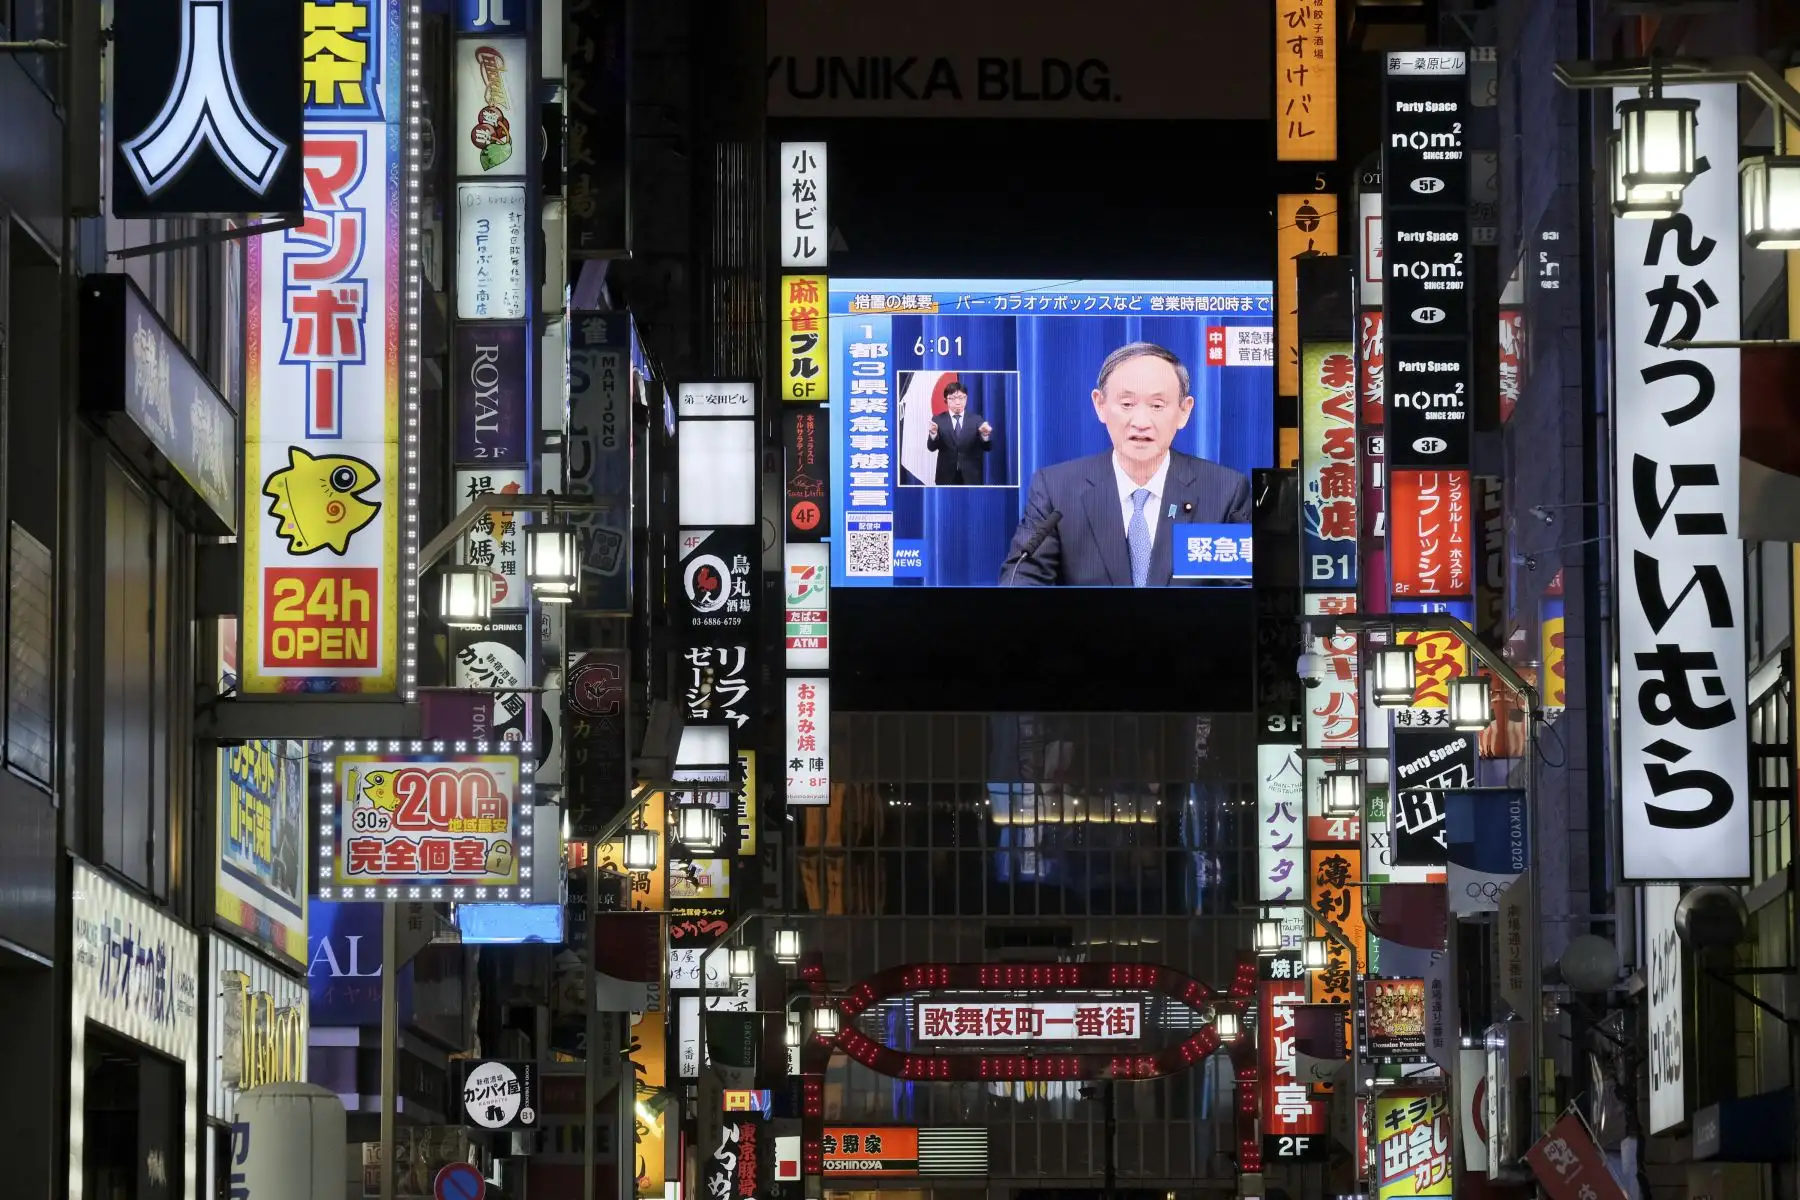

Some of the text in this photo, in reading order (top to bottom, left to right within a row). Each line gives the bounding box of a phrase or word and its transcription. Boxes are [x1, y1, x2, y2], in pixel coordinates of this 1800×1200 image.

[1389, 57, 1464, 71] 第一桑原ビル
[978, 56, 1122, 103] BLDG.
[1396, 101, 1458, 113] Party Space
[1423, 151, 1462, 160] SINCE 2007
[1418, 180, 1437, 191] 5F
[792, 150, 817, 259] 小松ビル
[1397, 231, 1459, 243] Party Space
[291, 140, 360, 431] マンボー
[1424, 281, 1464, 290] SINCE 2007
[854, 294, 932, 311] 措置の概要
[1419, 309, 1437, 321] 4F
[914, 336, 963, 358] 6:01
[1209, 331, 1223, 361] 中継
[1398, 361, 1460, 373] Party Space
[471, 344, 499, 442] ROYAL
[792, 382, 816, 398] 6F
[684, 394, 748, 405] 第二安田ビル
[1425, 411, 1465, 420] SINCE 2007
[474, 447, 508, 458] 2F
[1421, 440, 1439, 451] 3F
[1631, 155, 1738, 830] んかつにいむら
[795, 509, 814, 523] 4F
[858, 522, 881, 530] 配信中
[1417, 473, 1441, 594] リフレッシュ
[1448, 473, 1463, 589] レンタルルーム ホステル
[683, 536, 700, 548] 4F
[896, 550, 920, 558] NHK
[893, 559, 922, 567] NEWS
[1395, 583, 1410, 593] 2F
[273, 577, 370, 622] 24h
[692, 617, 742, 626] 03-6886-6759
[790, 611, 821, 622] たばこ
[492, 624, 523, 632] DRINKS
[271, 628, 368, 660] OPEN
[793, 638, 819, 648] ATM
[797, 683, 816, 752] お好み焼
[789, 757, 825, 772] 本陣
[1398, 737, 1467, 779] Party Space
[355, 811, 390, 829] 30分
[1327, 819, 1360, 841] 4F
[1509, 799, 1523, 870] TOKYO 2020
[350, 838, 486, 872] 完全個室
[1266, 801, 1298, 901] バンタイ
[308, 935, 383, 977] AL
[924, 1007, 1135, 1037] 歌舞伎町一番街
[683, 1038, 696, 1076] 一番街
[464, 1078, 521, 1103] カンパイ屋
[522, 1111, 533, 1120] B1
[823, 1134, 882, 1155] 吉野家
[1278, 1136, 1310, 1157] 2F
